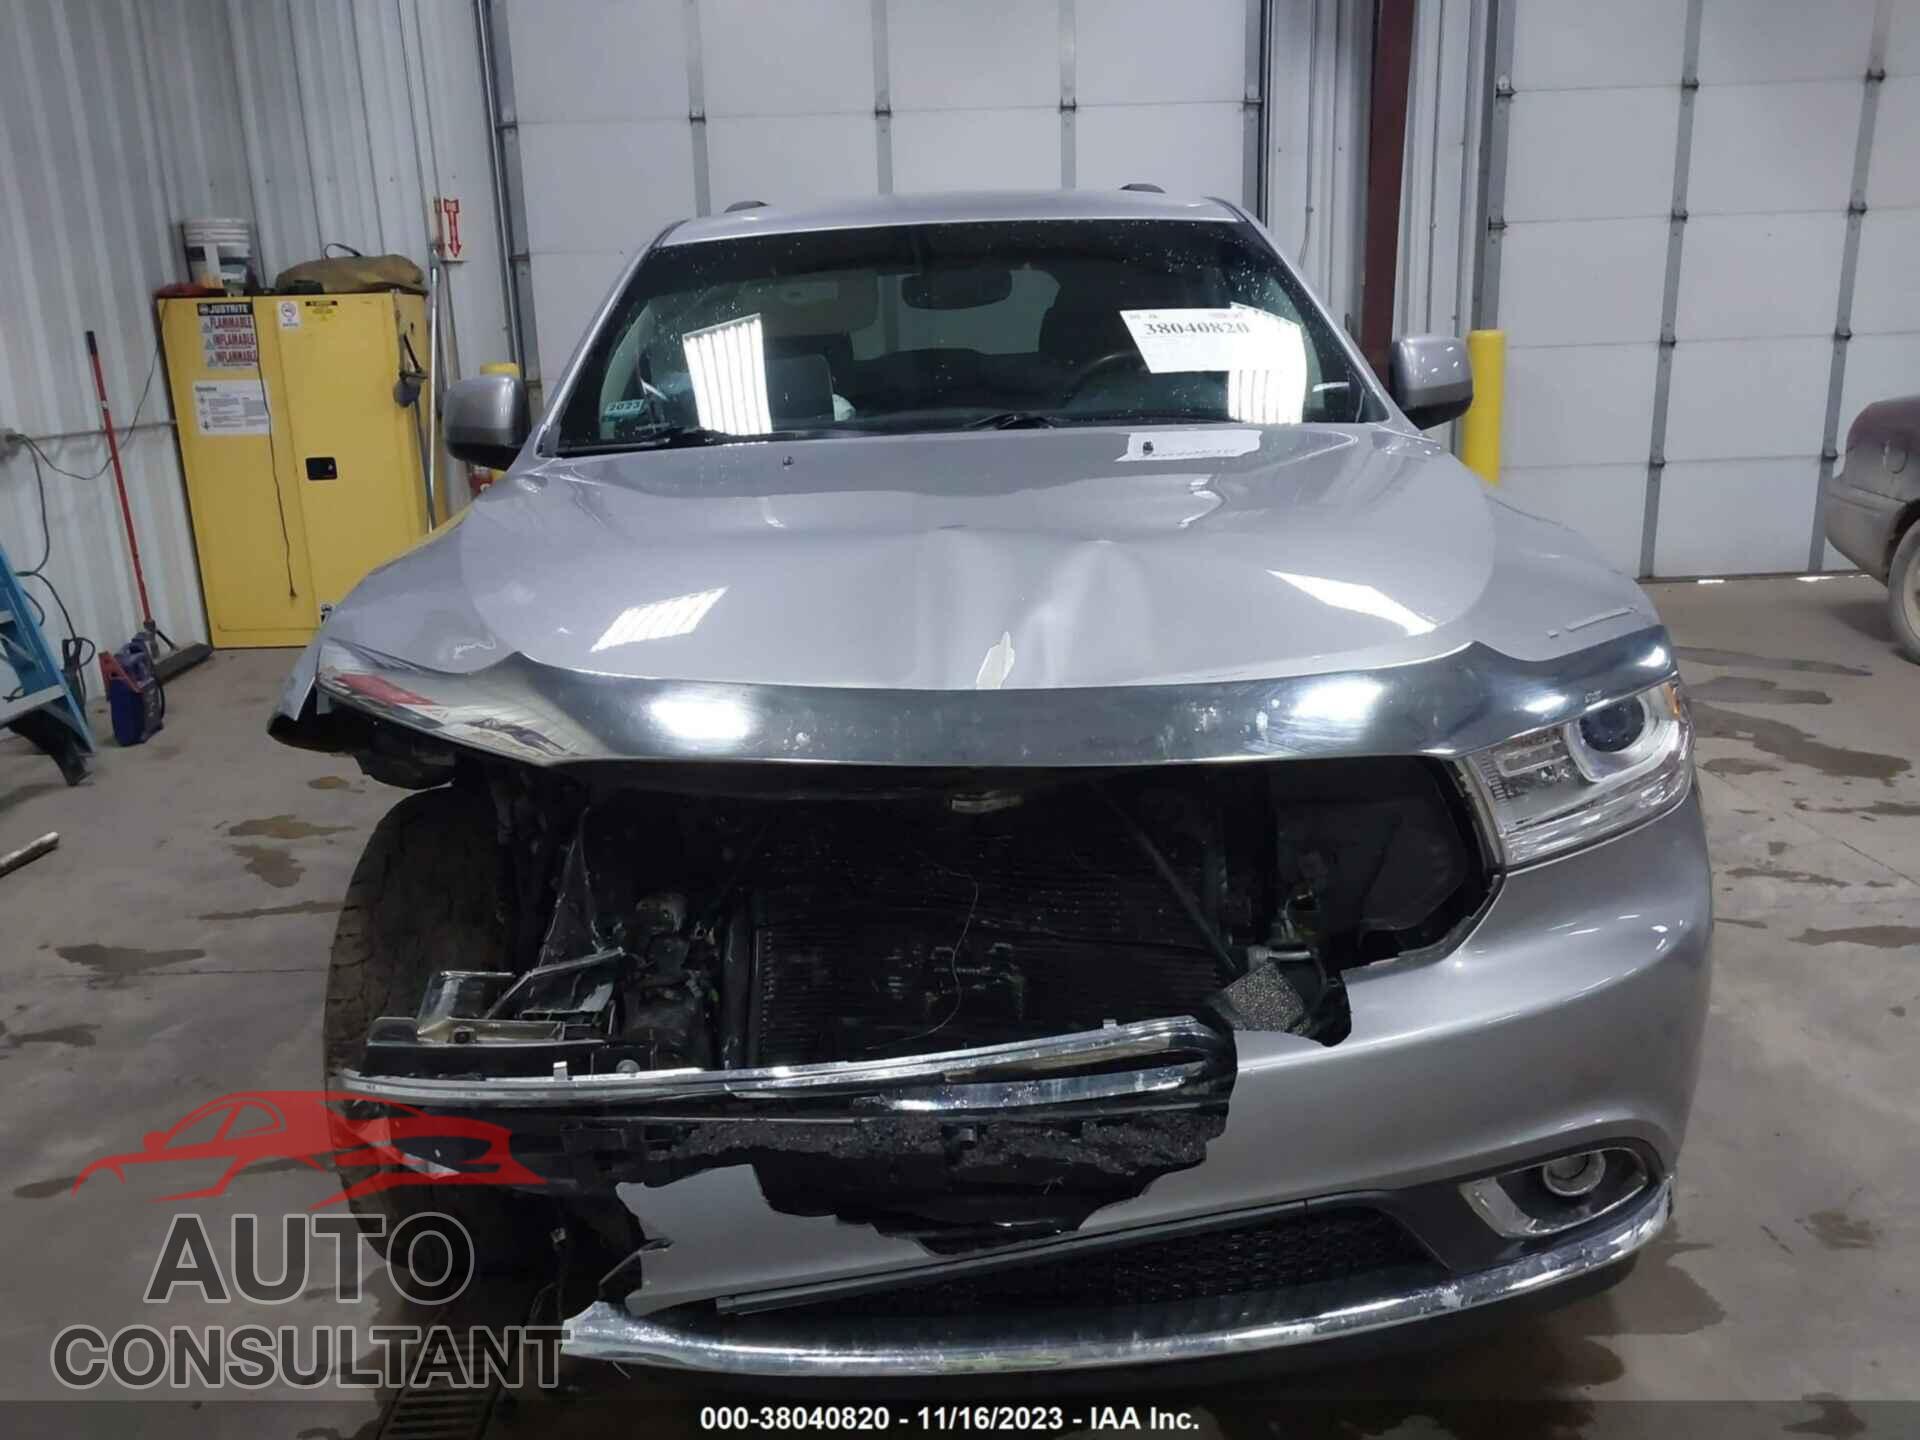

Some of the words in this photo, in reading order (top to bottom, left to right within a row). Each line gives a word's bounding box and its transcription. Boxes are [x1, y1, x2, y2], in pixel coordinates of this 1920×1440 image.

[209, 304, 248, 313] JUSTRITE
[209, 315, 252, 329] FLAMMABLE
[1144, 321, 1251, 336] 38040820
